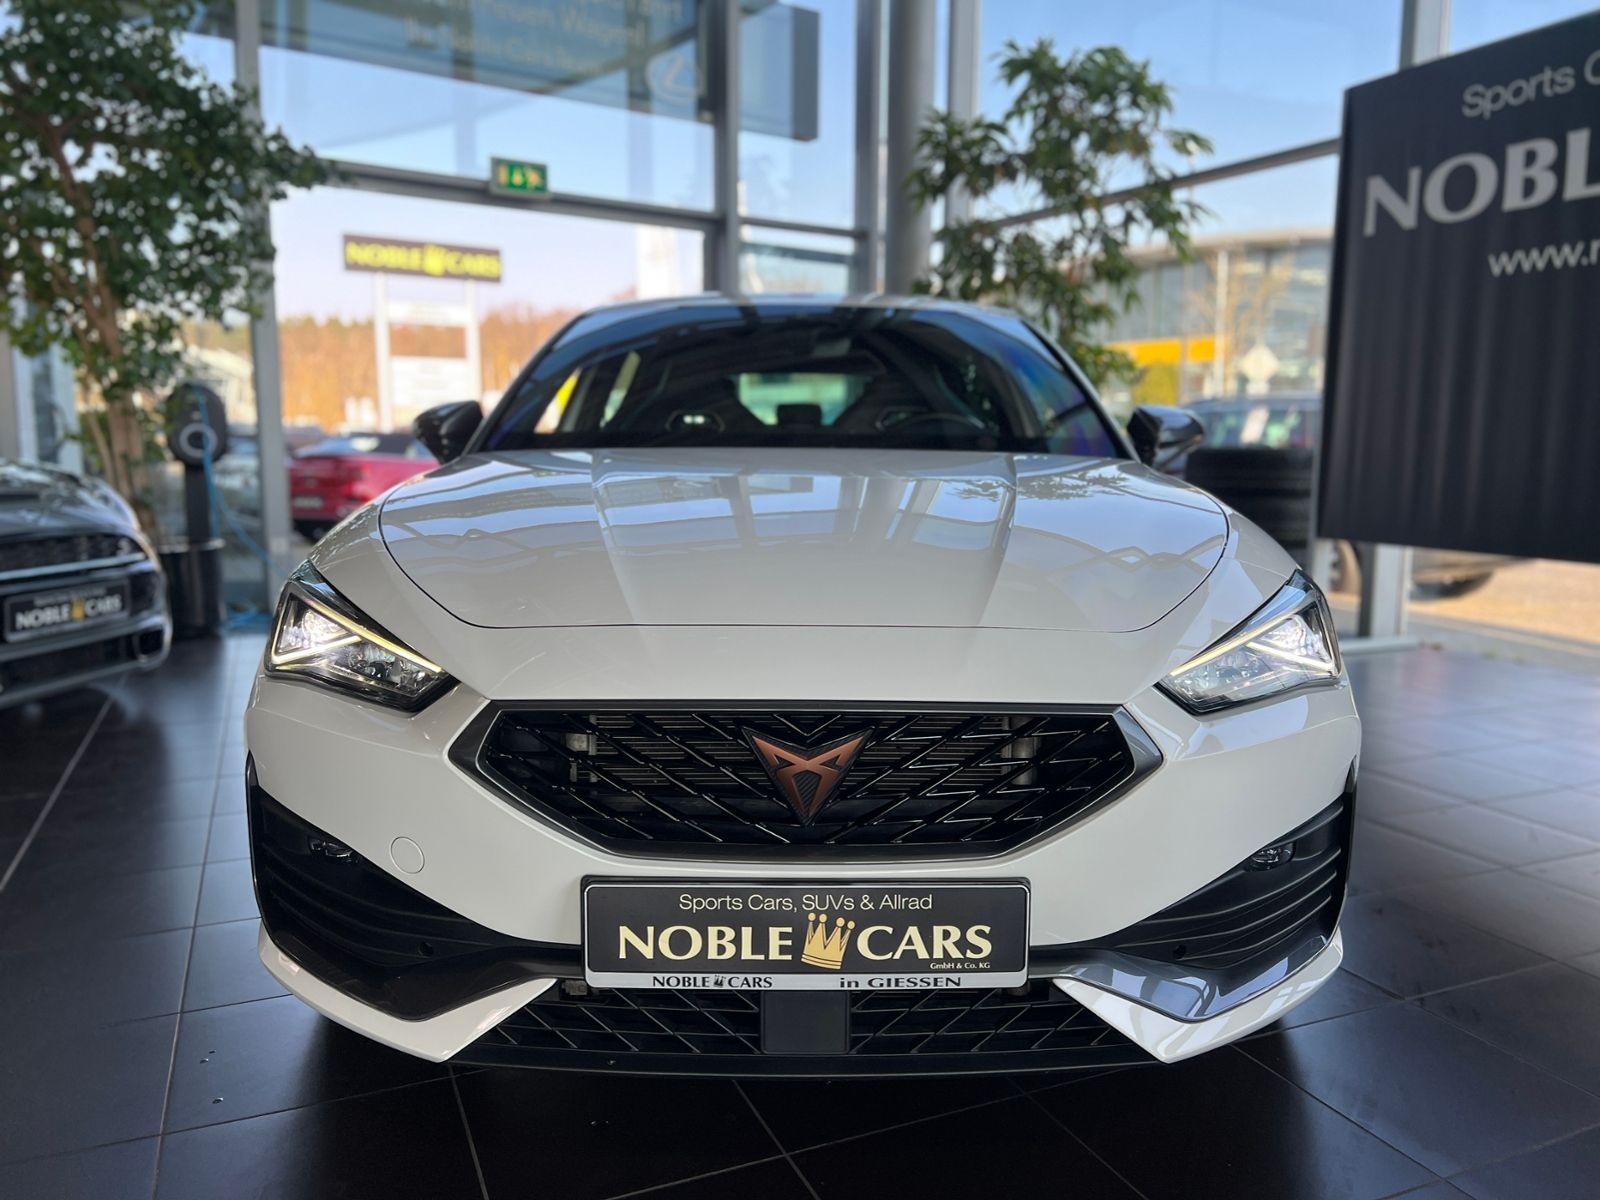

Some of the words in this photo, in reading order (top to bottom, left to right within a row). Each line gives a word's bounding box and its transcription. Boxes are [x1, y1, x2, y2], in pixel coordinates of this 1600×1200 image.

[1461, 65, 1577, 120] Sports
[346, 242, 422, 271] NOBLE
[446, 251, 500, 278] CARS
[15, 603, 71, 630] NOBLE
[85, 593, 122, 617] CARS
[679, 893, 743, 913] Sports
[747, 894, 797, 913] Cars,
[801, 894, 855, 911] SUVs
[860, 894, 875, 911] &
[879, 894, 933, 910] Allrad
[618, 925, 793, 961] NOBLE
[856, 925, 992, 960] CARS
[652, 976, 710, 988] NOBLE
[728, 976, 773, 988] CARS
[840, 977, 859, 988] in
[867, 976, 961, 988] GIESSEN
